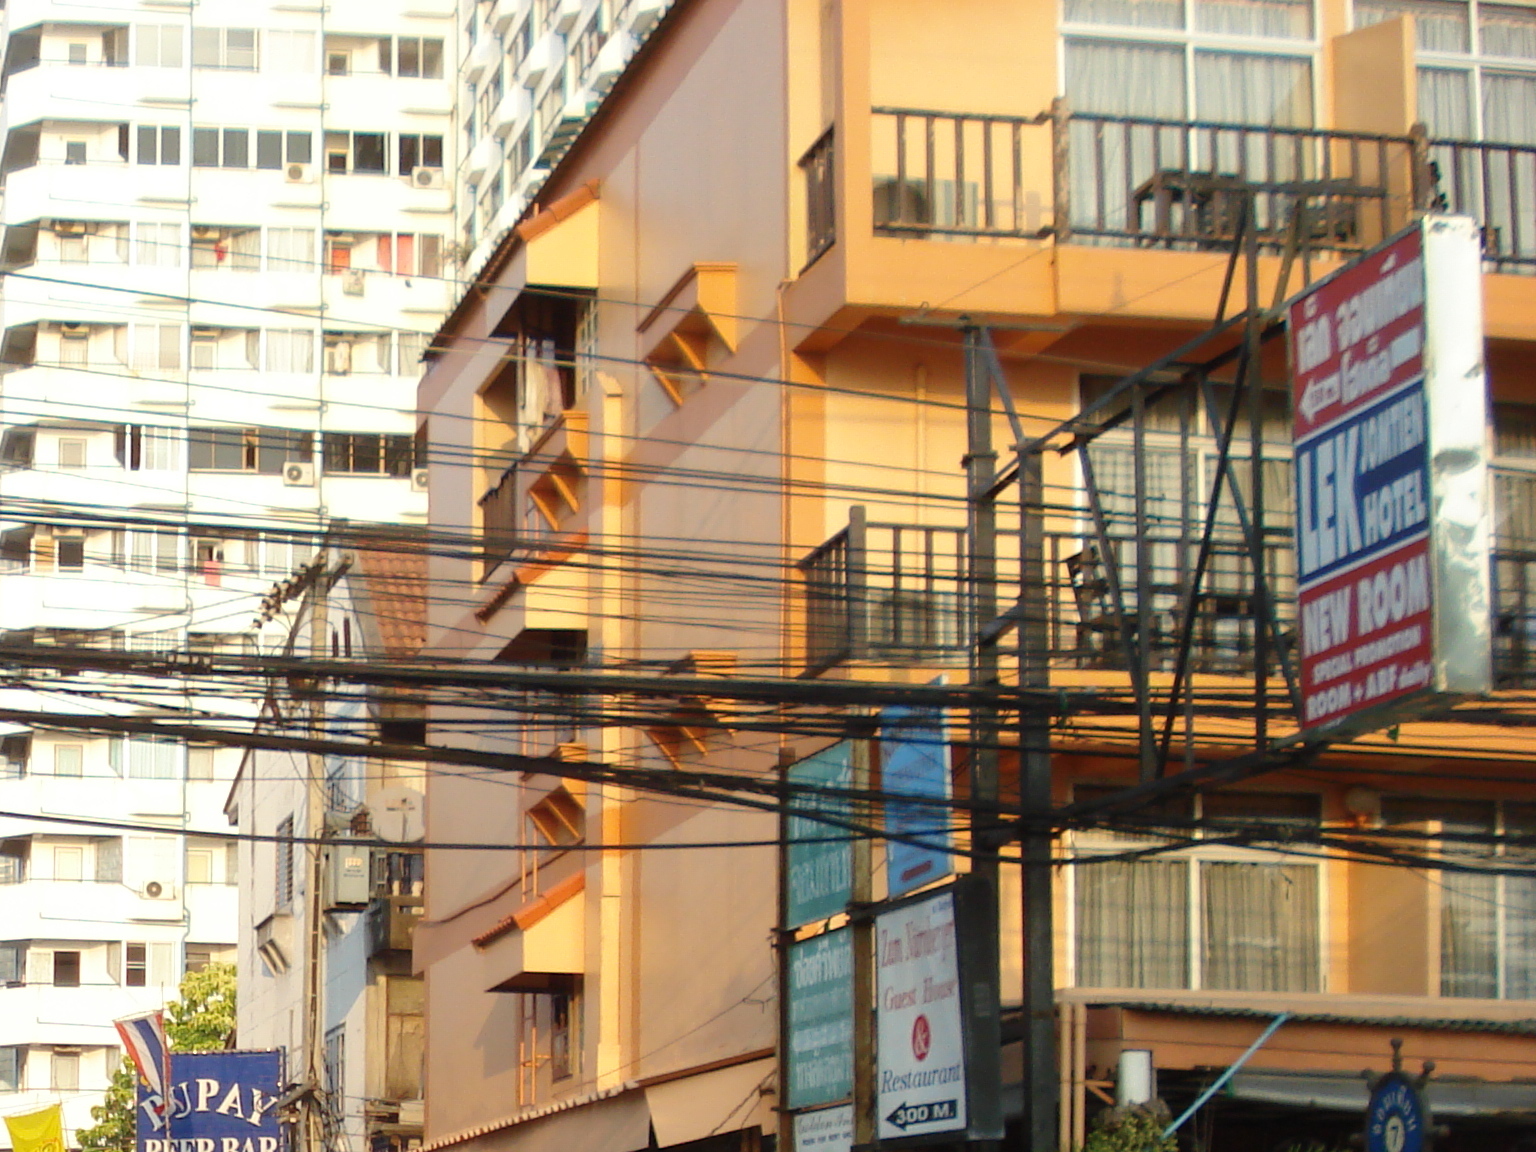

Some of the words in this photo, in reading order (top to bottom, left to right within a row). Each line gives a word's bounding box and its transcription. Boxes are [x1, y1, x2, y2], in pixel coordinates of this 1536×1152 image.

[1299, 424, 1362, 576] LEK
[1363, 469, 1427, 548] HOTEL
[1302, 584, 1352, 659] NEW
[1356, 553, 1430, 636] ROOM
[1306, 681, 1352, 722] ROOM
[883, 986, 918, 1011] Guest
[923, 977, 958, 1005] House
[880, 1063, 961, 1094] Restaurant
[139, 1078, 279, 1132] PUPAY
[895, 1105, 928, 1125] 300
